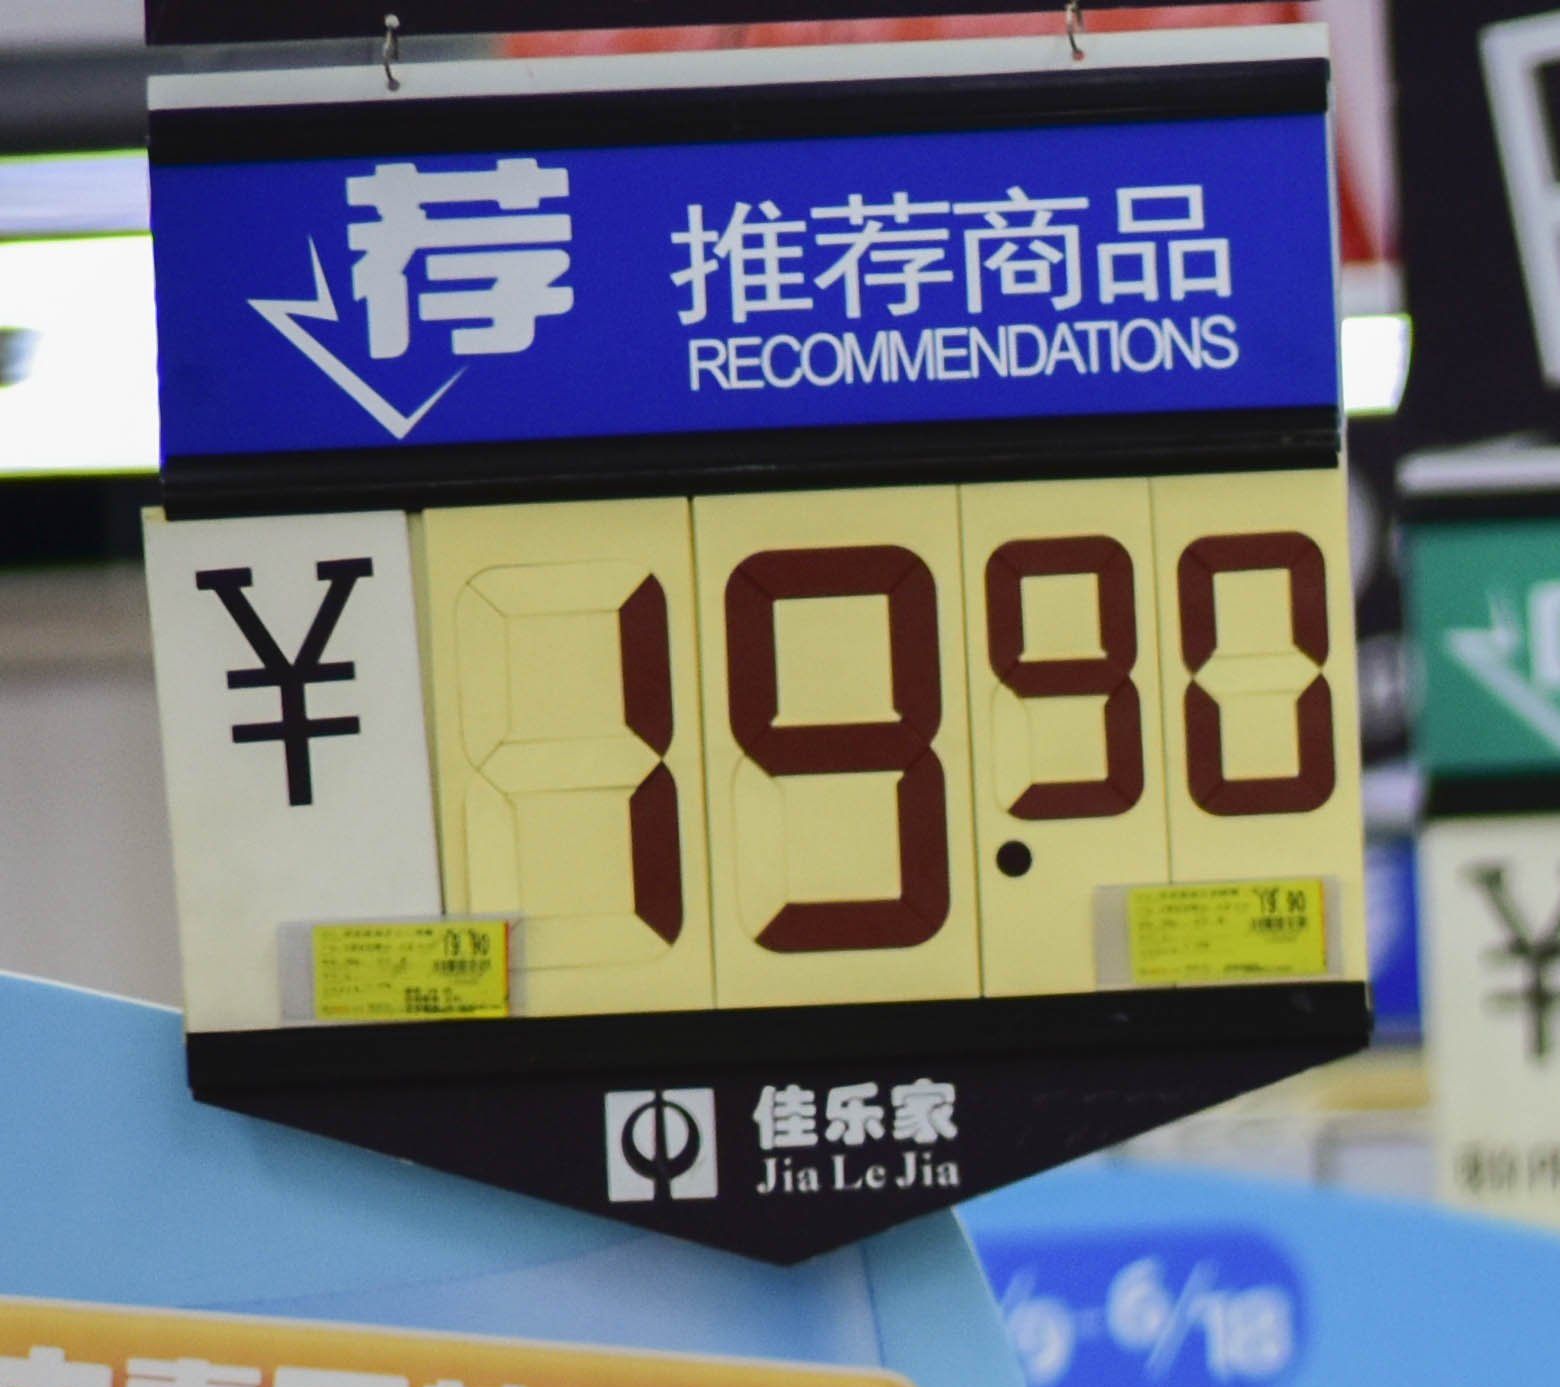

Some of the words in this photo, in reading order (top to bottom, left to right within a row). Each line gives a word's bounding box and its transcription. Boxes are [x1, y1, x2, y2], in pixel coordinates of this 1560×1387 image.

[346, 158, 575, 359] 荐
[669, 185, 1234, 327] 推荐商品
[687, 316, 1239, 392] RECOMMENDATIONS
[196, 557, 375, 806] ¥
[617, 531, 1337, 953] 19.90
[753, 1078, 958, 1150] 佳乐家
[757, 1157, 820, 1195] Jia
[832, 1153, 887, 1190] Le
[896, 1151, 960, 1187] Jia
